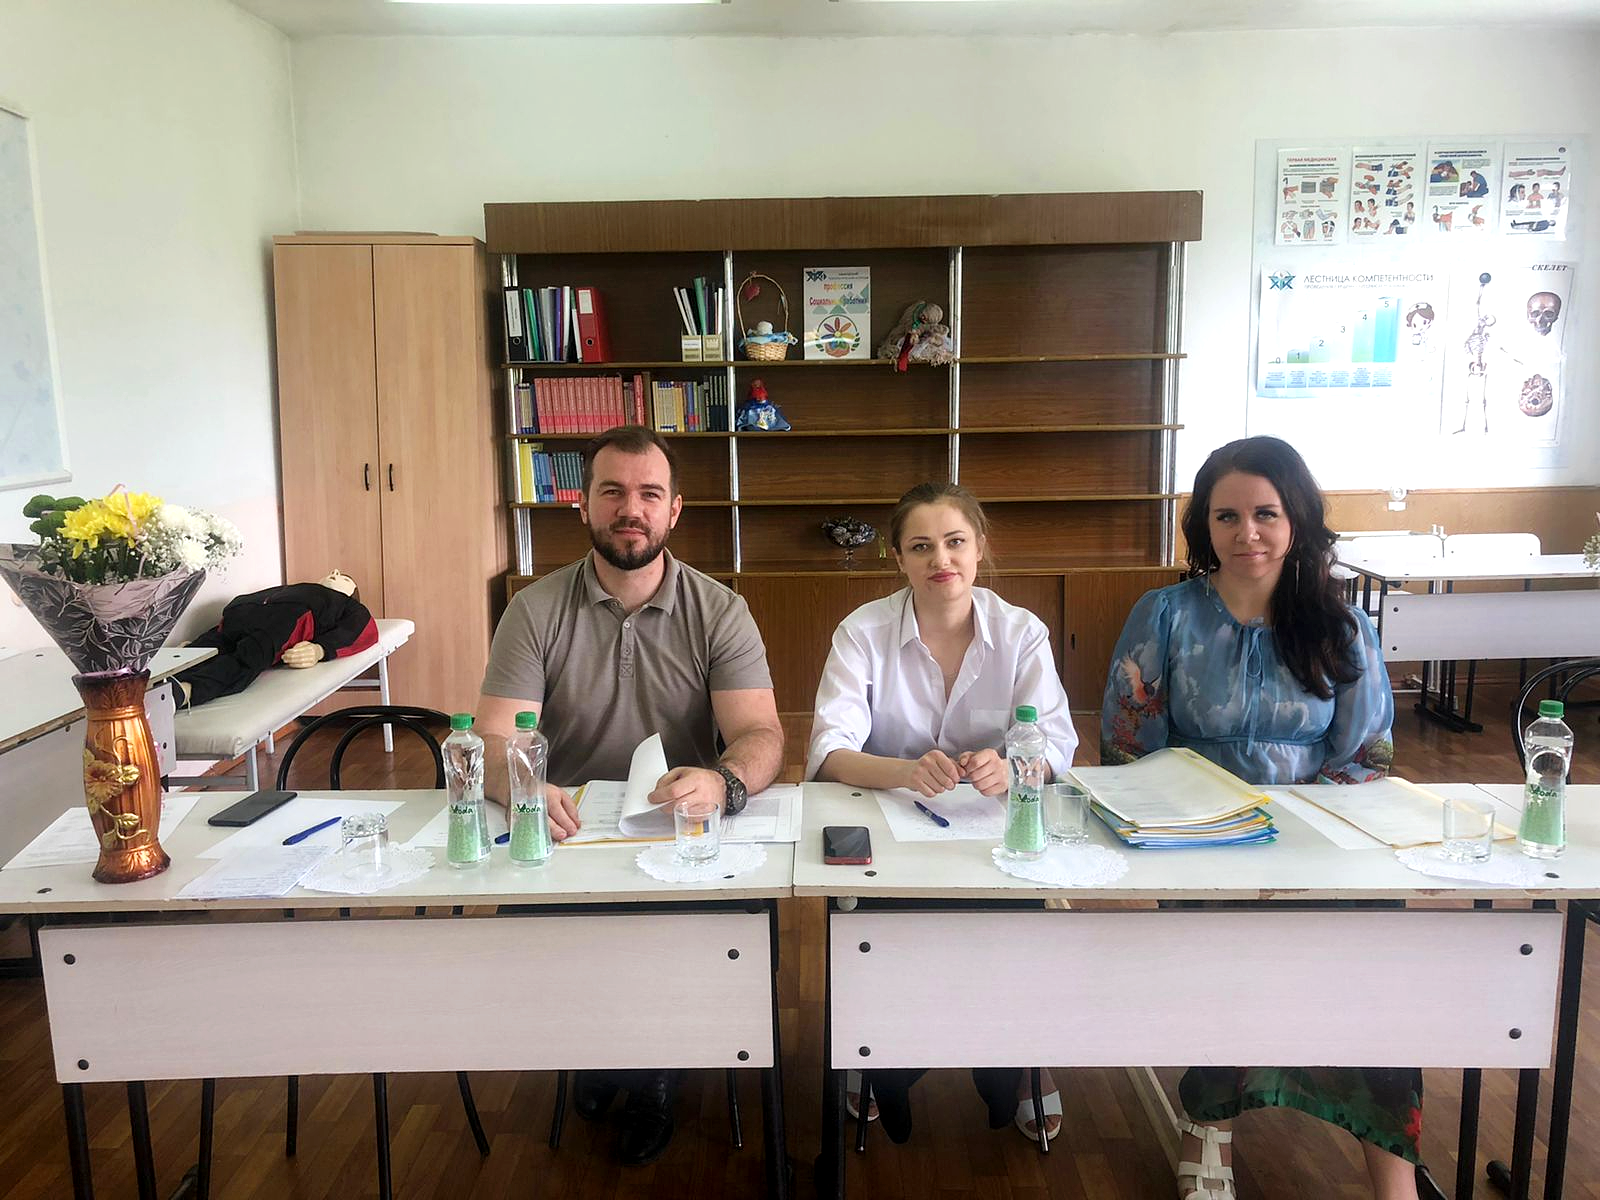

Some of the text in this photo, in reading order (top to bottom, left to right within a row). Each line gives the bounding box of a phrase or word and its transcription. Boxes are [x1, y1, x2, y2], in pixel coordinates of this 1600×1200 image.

[1531, 264, 1568, 272] СКЕЛЕТ
[1303, 273, 1434, 284] ЛЕСТНИЦА КОМПЕТЕНТНОСТИ
[1362, 313, 1368, 321] 4
[1318, 339, 1325, 347] 2
